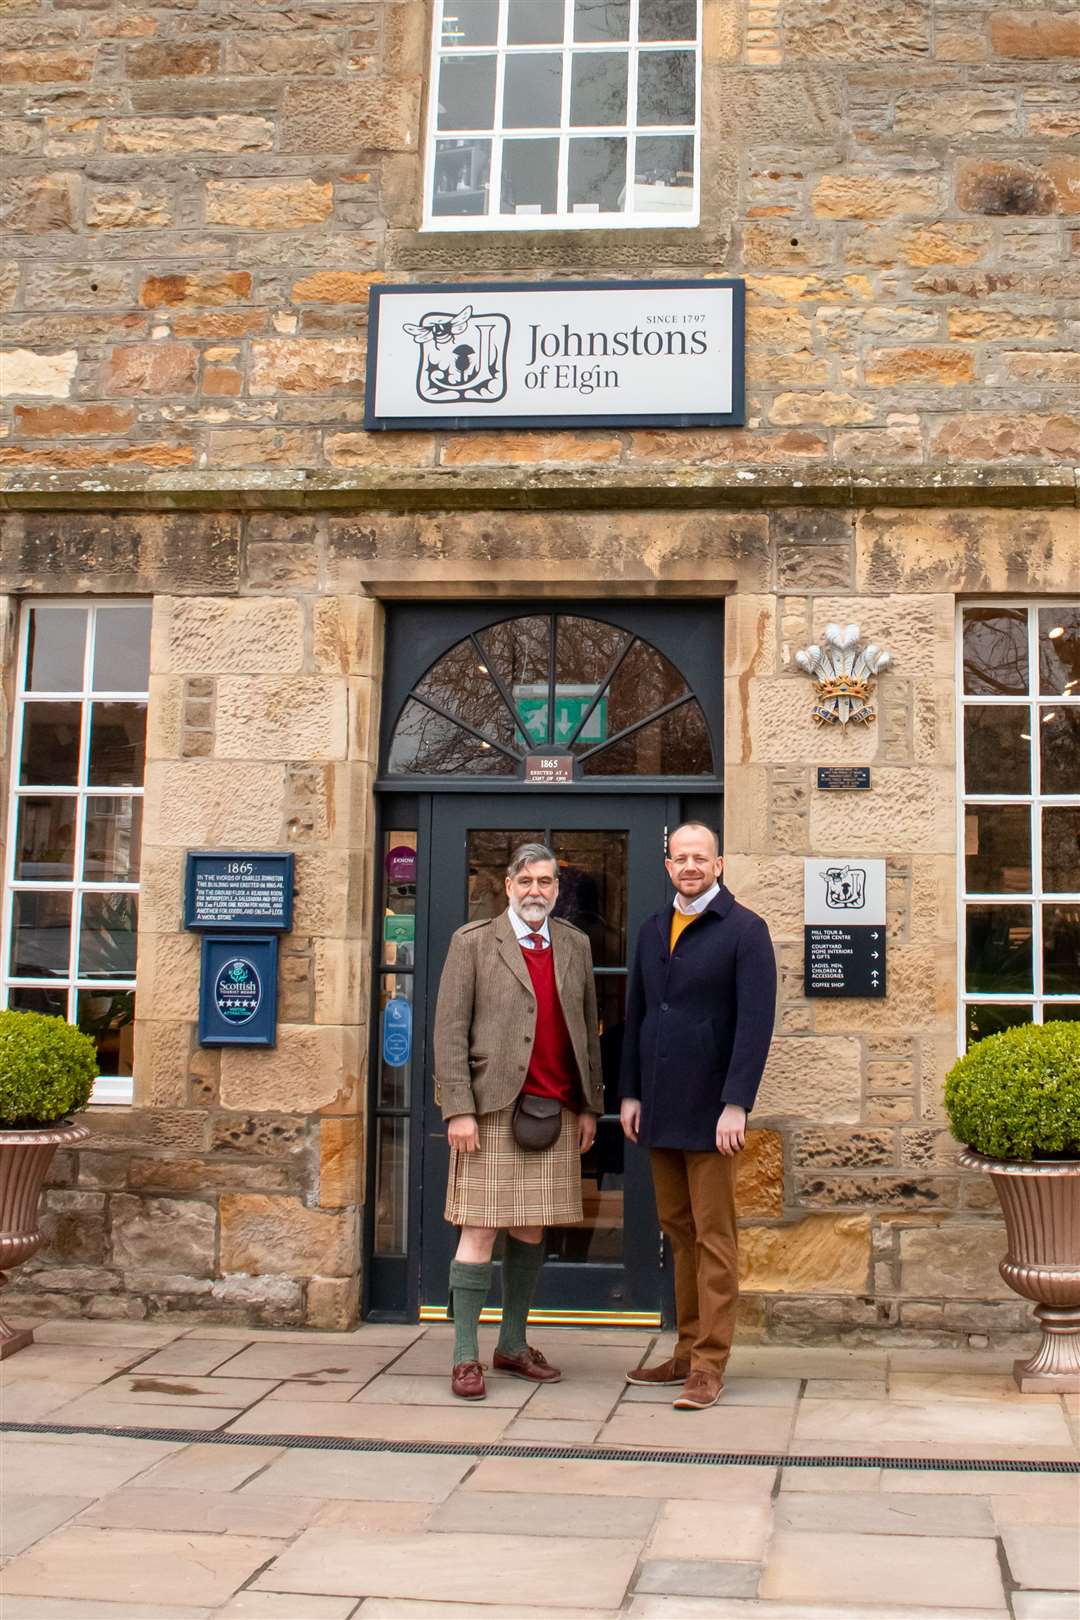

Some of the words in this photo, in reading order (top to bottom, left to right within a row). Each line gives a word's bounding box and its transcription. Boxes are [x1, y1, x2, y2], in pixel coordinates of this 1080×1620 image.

[646, 314, 678, 324] SINCE
[683, 314, 706, 324] 1797
[526, 323, 708, 366] Johnstons
[524, 364, 550, 390] of
[555, 364, 620, 395] Elgin
[541, 760, 558, 768] 1865
[228, 863, 253, 874] 1865
[219, 980, 256, 990] Scottish
